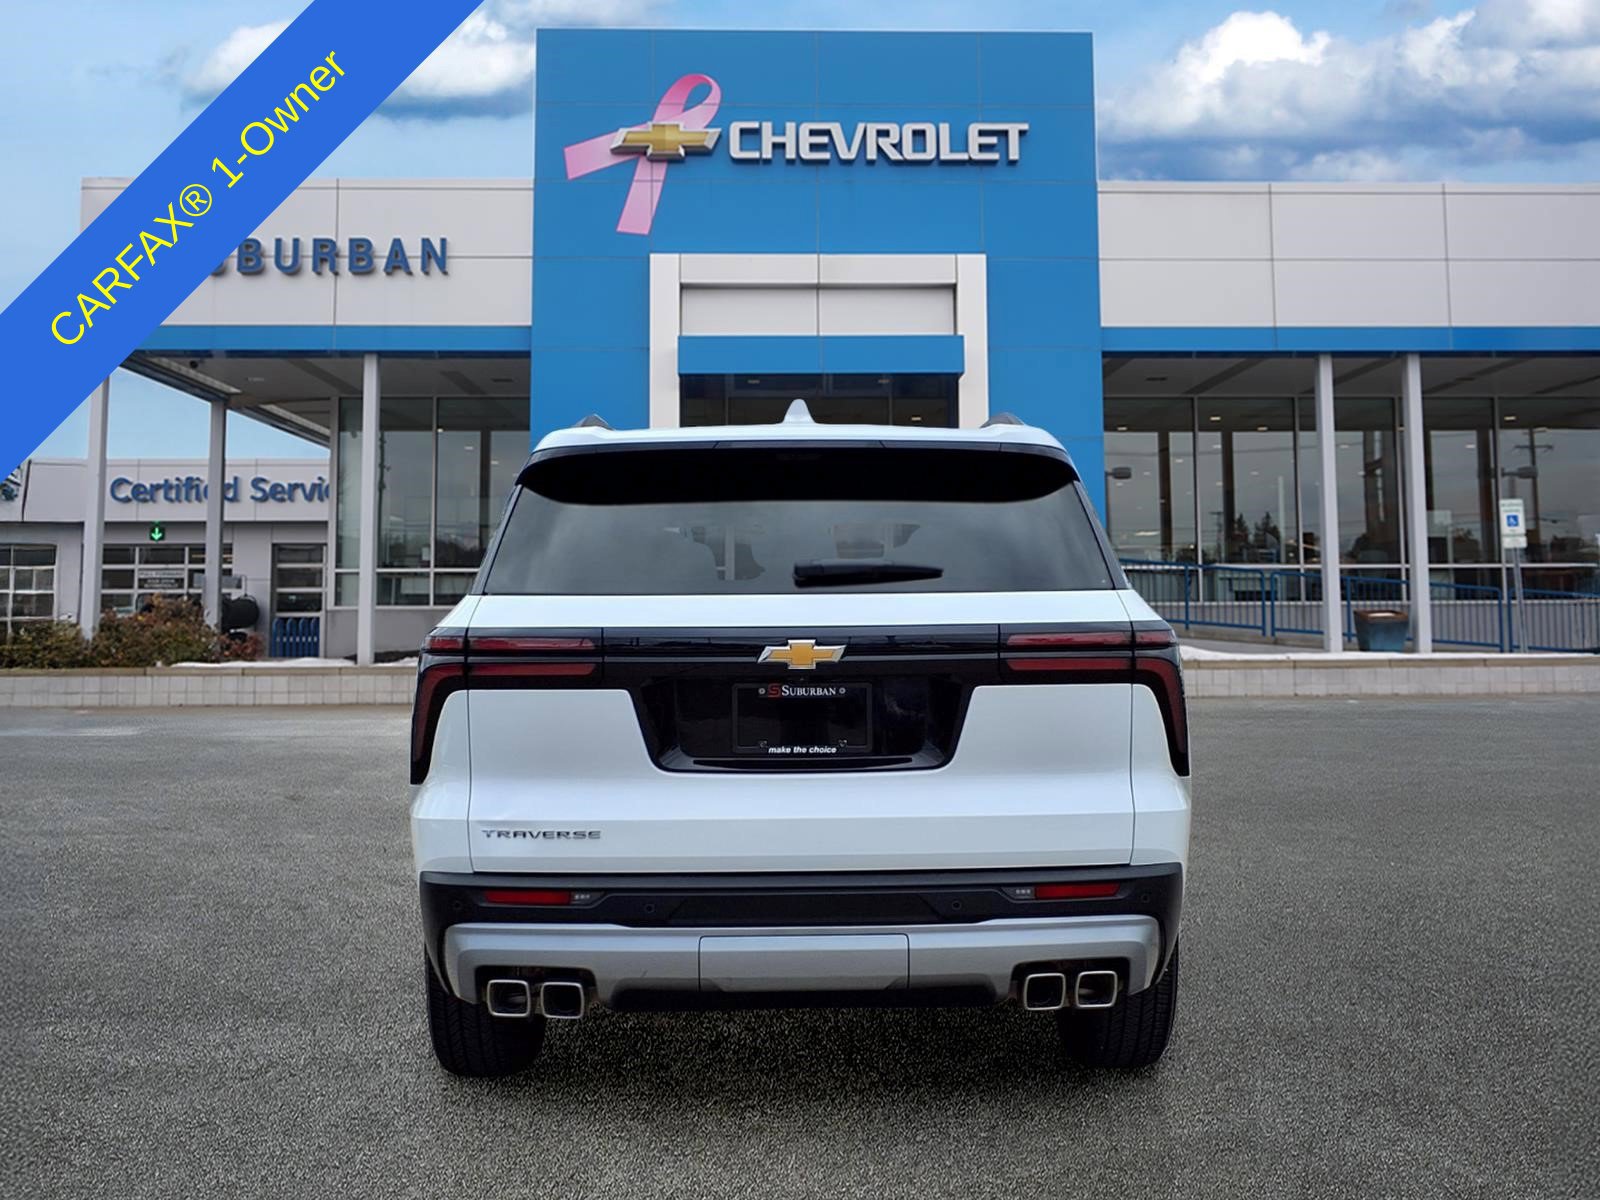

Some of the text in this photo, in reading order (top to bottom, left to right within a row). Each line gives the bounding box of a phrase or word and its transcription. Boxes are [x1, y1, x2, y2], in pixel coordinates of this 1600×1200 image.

[729, 120, 1029, 161] CHEVROLET
[210, 237, 447, 275] BURBAN
[768, 746, 837, 754] make the choice
[481, 830, 601, 839] TRAVERSE
